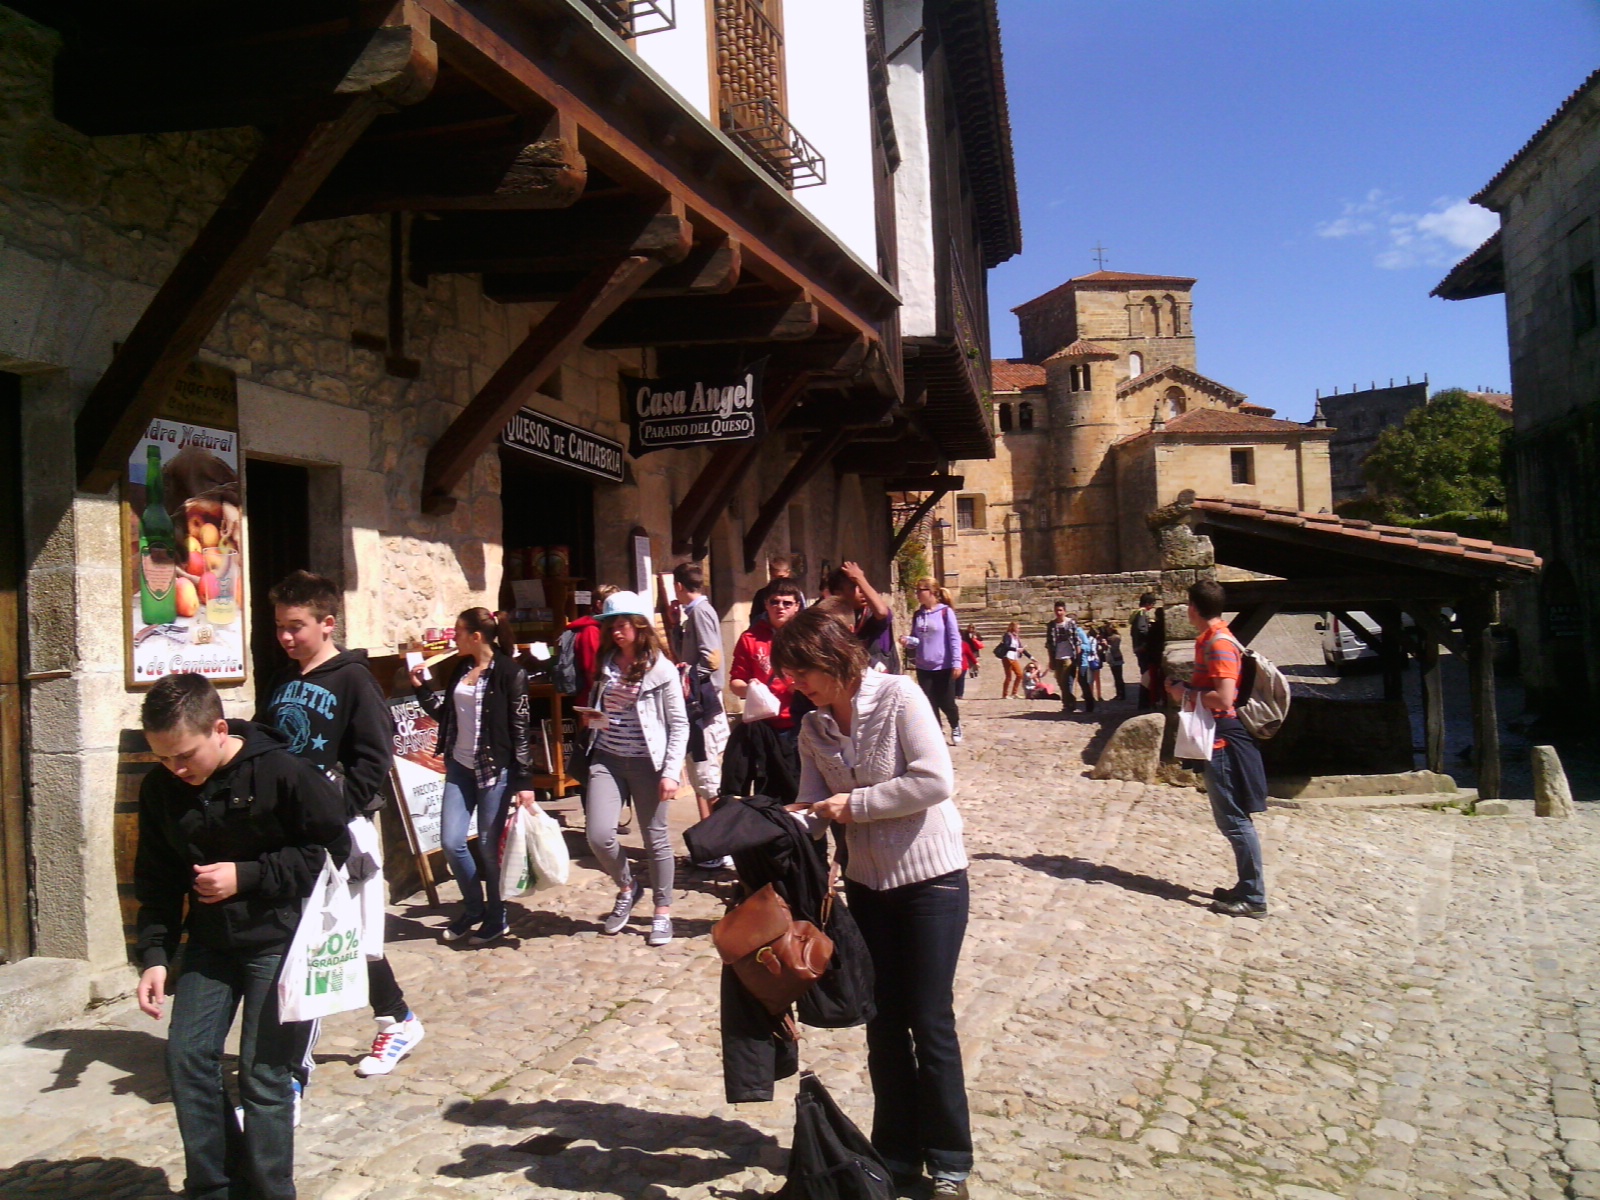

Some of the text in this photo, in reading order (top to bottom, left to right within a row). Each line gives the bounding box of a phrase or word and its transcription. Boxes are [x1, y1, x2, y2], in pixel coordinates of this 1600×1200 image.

[636, 373, 754, 419] Casa Angel
[143, 421, 233, 452] idra Natural
[644, 418, 750, 439] PARAISO DEL QUESO
[507, 414, 621, 474] QUESOS DE CANTABRIA
[146, 654, 238, 675] de Cantabria
[397, 716, 417, 736] de
[392, 729, 440, 756] SANTO
[412, 782, 438, 797] PRECIOS
